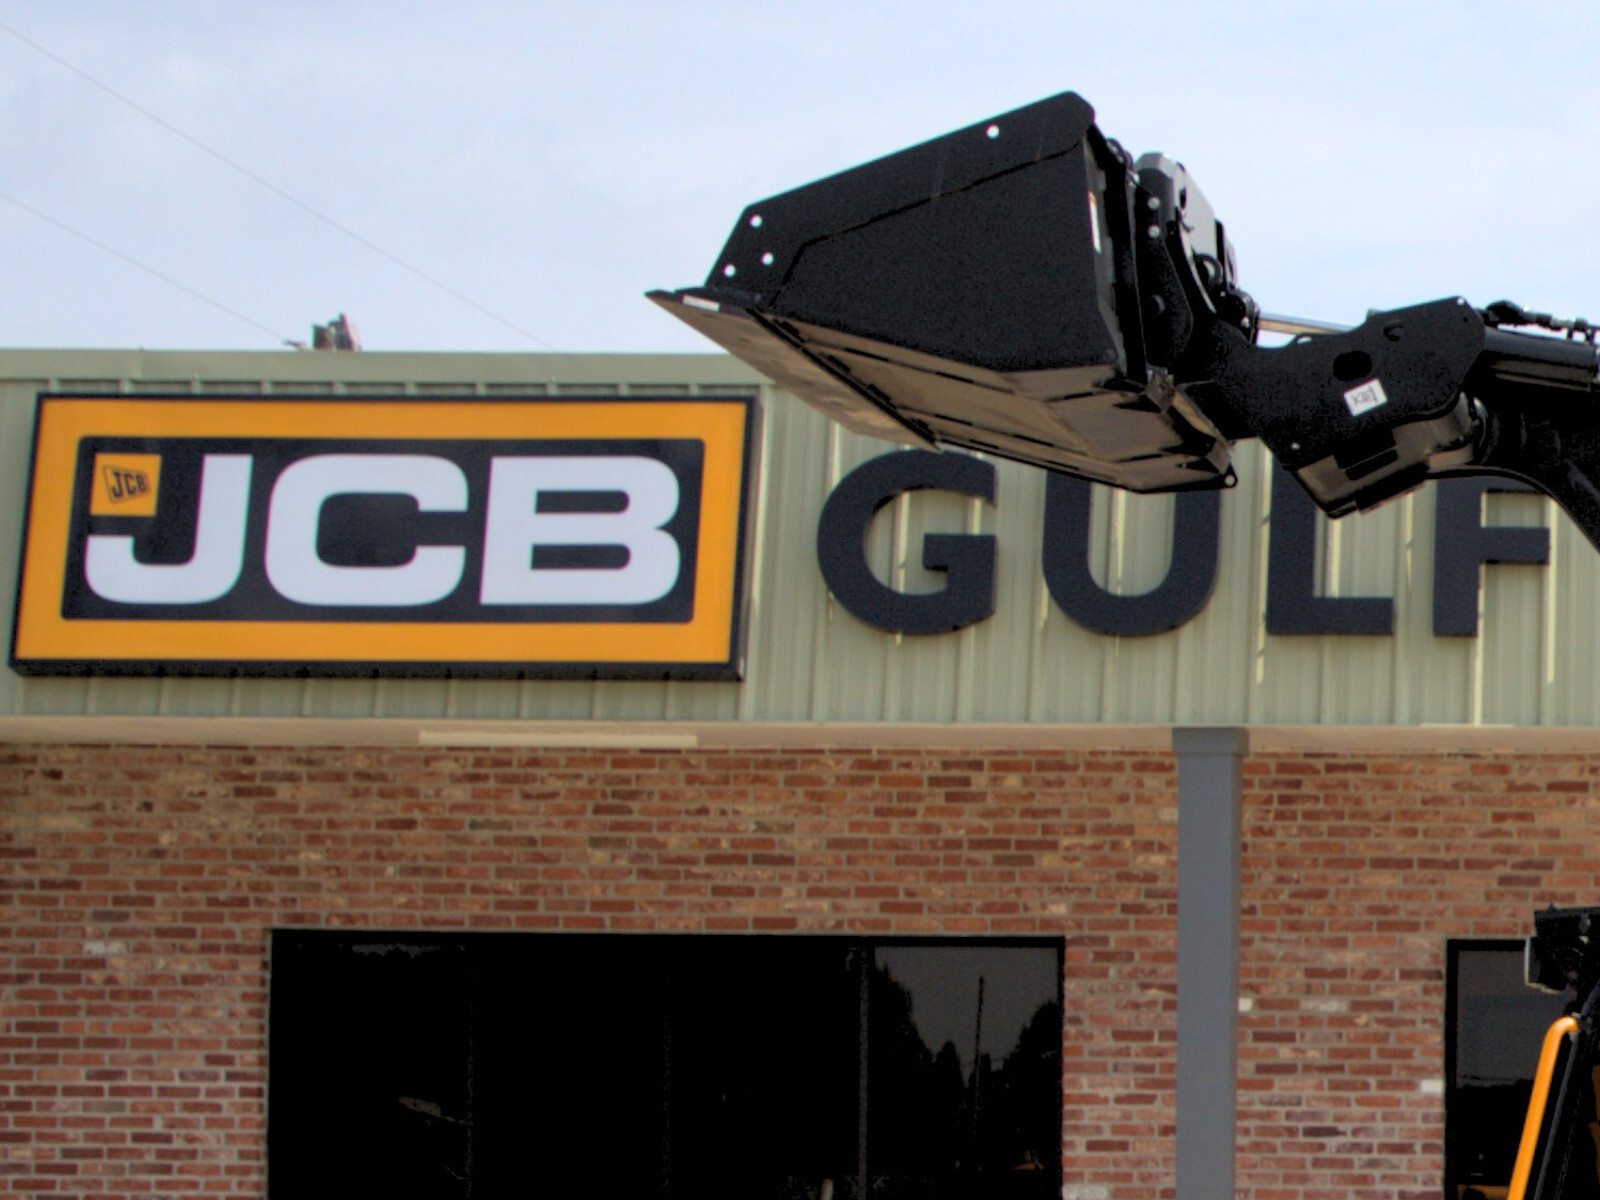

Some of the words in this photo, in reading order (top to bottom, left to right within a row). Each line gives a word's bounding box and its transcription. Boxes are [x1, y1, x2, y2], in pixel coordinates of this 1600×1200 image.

[84, 453, 681, 606] JCB
[111, 469, 149, 498] JCB
[816, 446, 1550, 637] GULF
